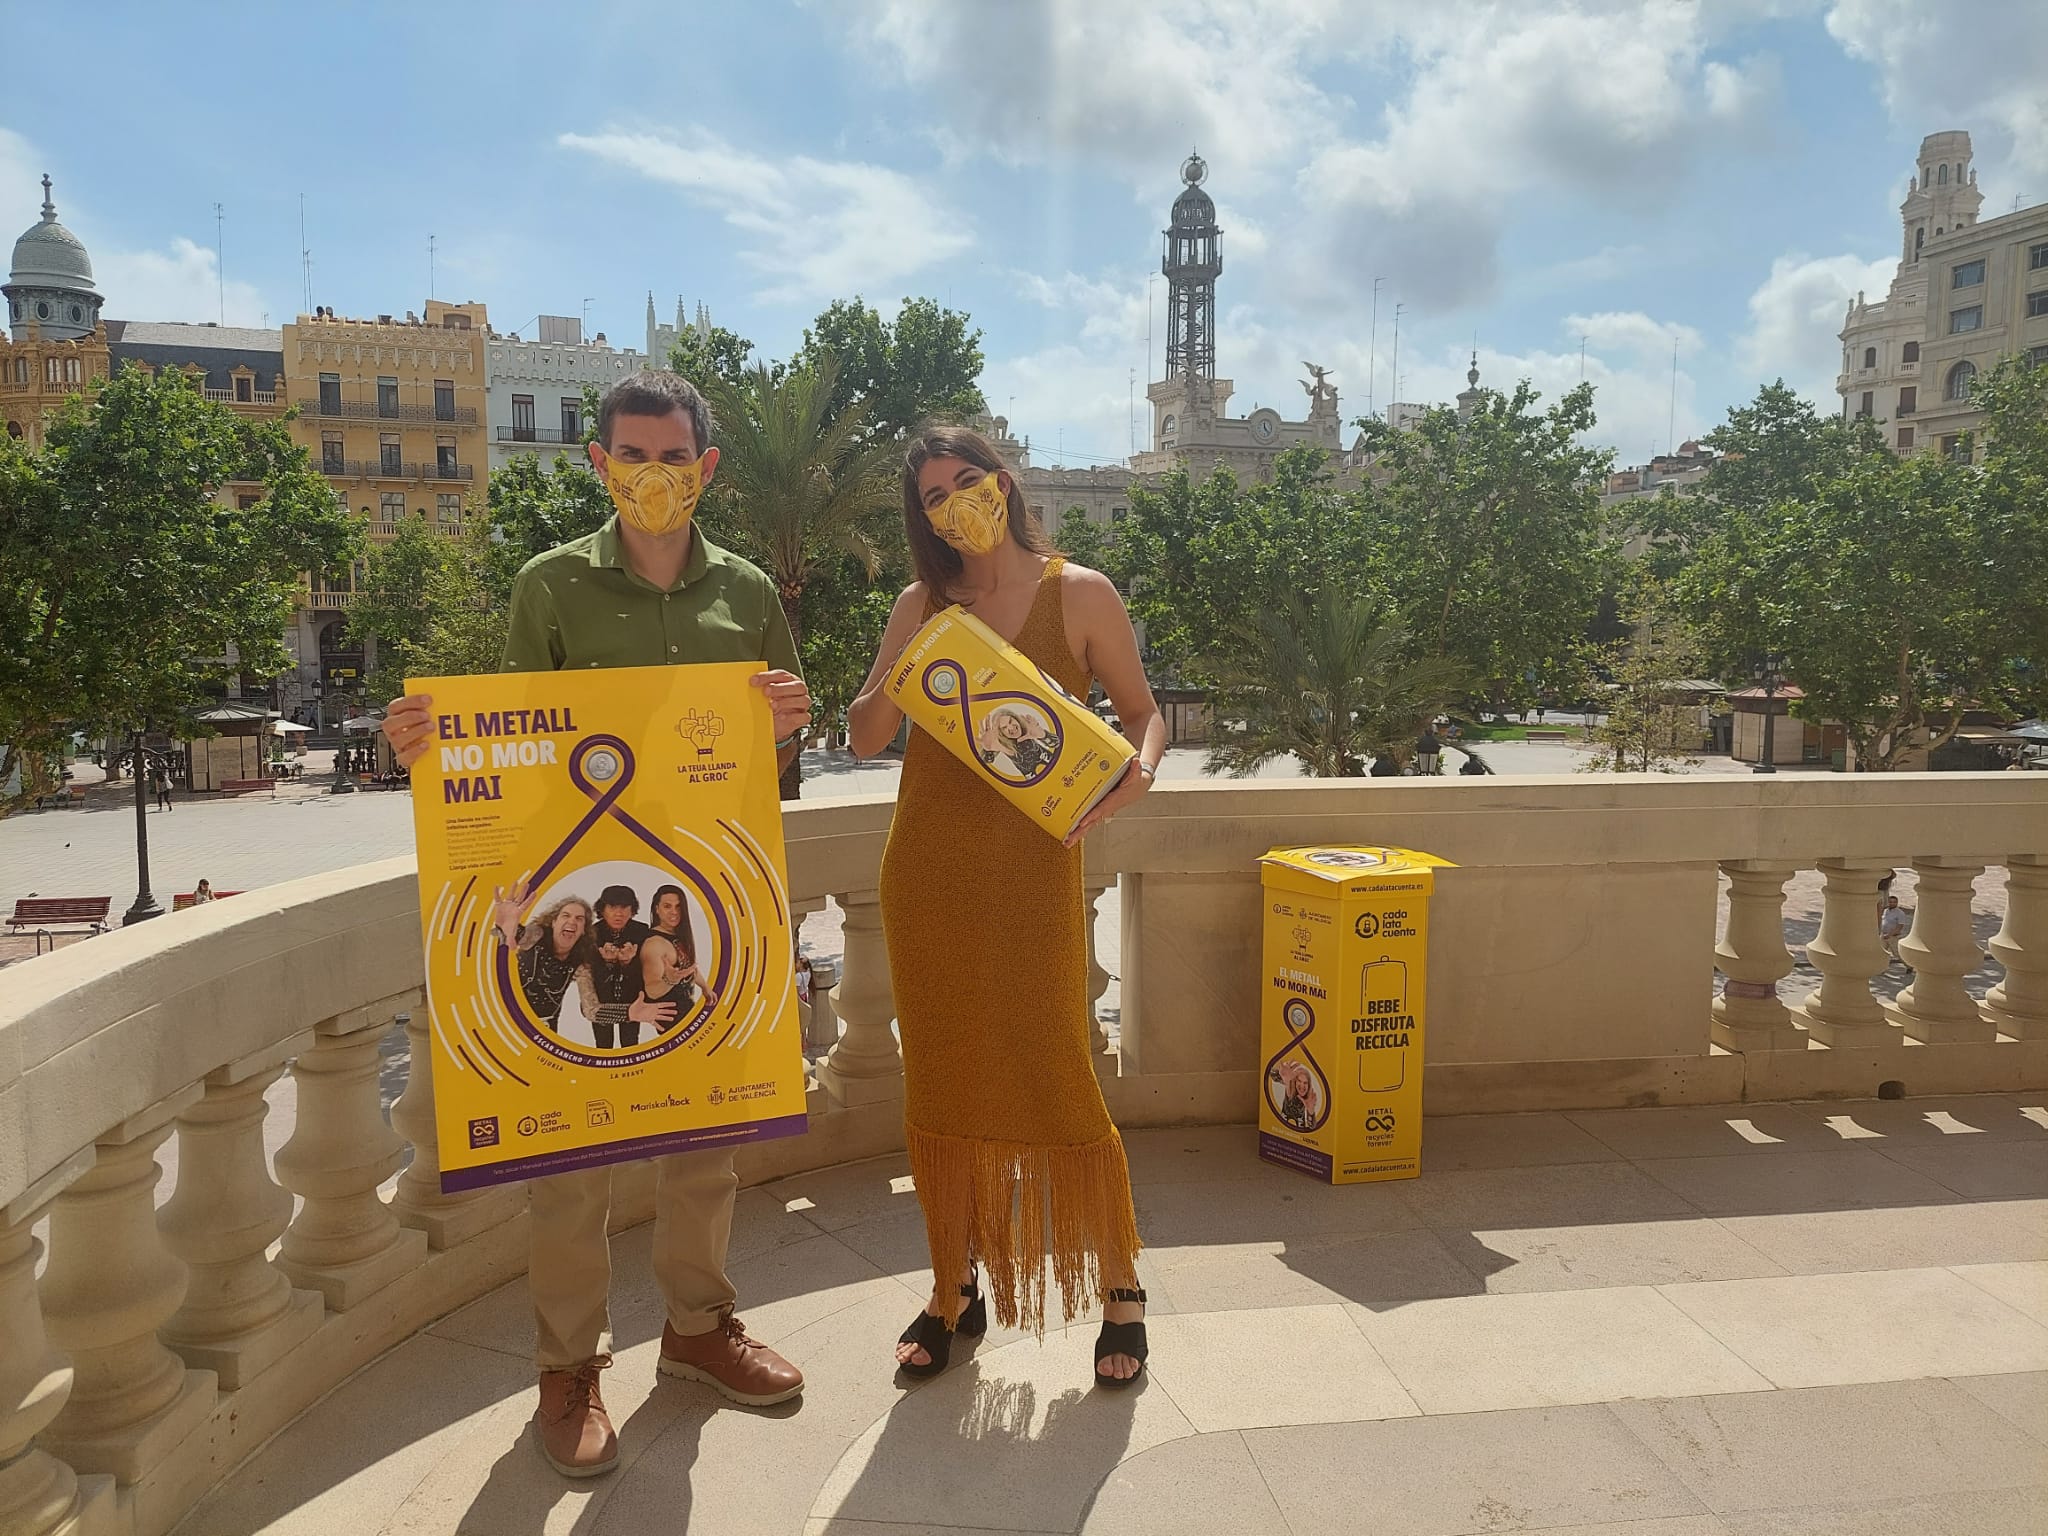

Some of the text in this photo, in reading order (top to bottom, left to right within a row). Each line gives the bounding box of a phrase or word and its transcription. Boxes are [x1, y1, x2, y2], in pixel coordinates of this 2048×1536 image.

[893, 620, 953, 694] EL METALL NO MOR MAI
[438, 707, 577, 740] EL METALL
[440, 740, 558, 773] NO MOR
[677, 762, 737, 773] LA TEUA LLANDA
[689, 772, 728, 783] AL GROC
[443, 775, 502, 804] MAI
[1351, 883, 1424, 893] www.cadalatacuenta.es
[1382, 909, 1407, 919] cada
[1382, 920, 1401, 928] lata
[1382, 928, 1416, 938] cuenta
[1279, 966, 1321, 987] EL METALL
[1273, 977, 1327, 1000] NO MOR MAI
[1368, 999, 1401, 1015] BEBE
[1351, 1016, 1415, 1034] DISFRUTA
[554, 1048, 583, 1064] SANCHO
[595, 1057, 634, 1067] MARISKAL
[636, 1046, 665, 1062] ROMERO
[674, 1030, 691, 1045] TETE
[687, 1009, 710, 1034] NOVOA
[687, 1021, 718, 1051] SARATOGA
[1355, 1033, 1410, 1051] RECICLA
[536, 1055, 565, 1072] LUJURIA
[621, 1069, 645, 1079] HEAVY
[728, 1081, 777, 1094] AJUNTAMENT
[729, 1094, 739, 1102] DE
[540, 1110, 562, 1120] cada
[540, 1119, 557, 1127] lata
[540, 1123, 571, 1134] cuenta
[1365, 1133, 1394, 1142] recycles
[1342, 1163, 1416, 1175] www.cadalatacuenta.es
